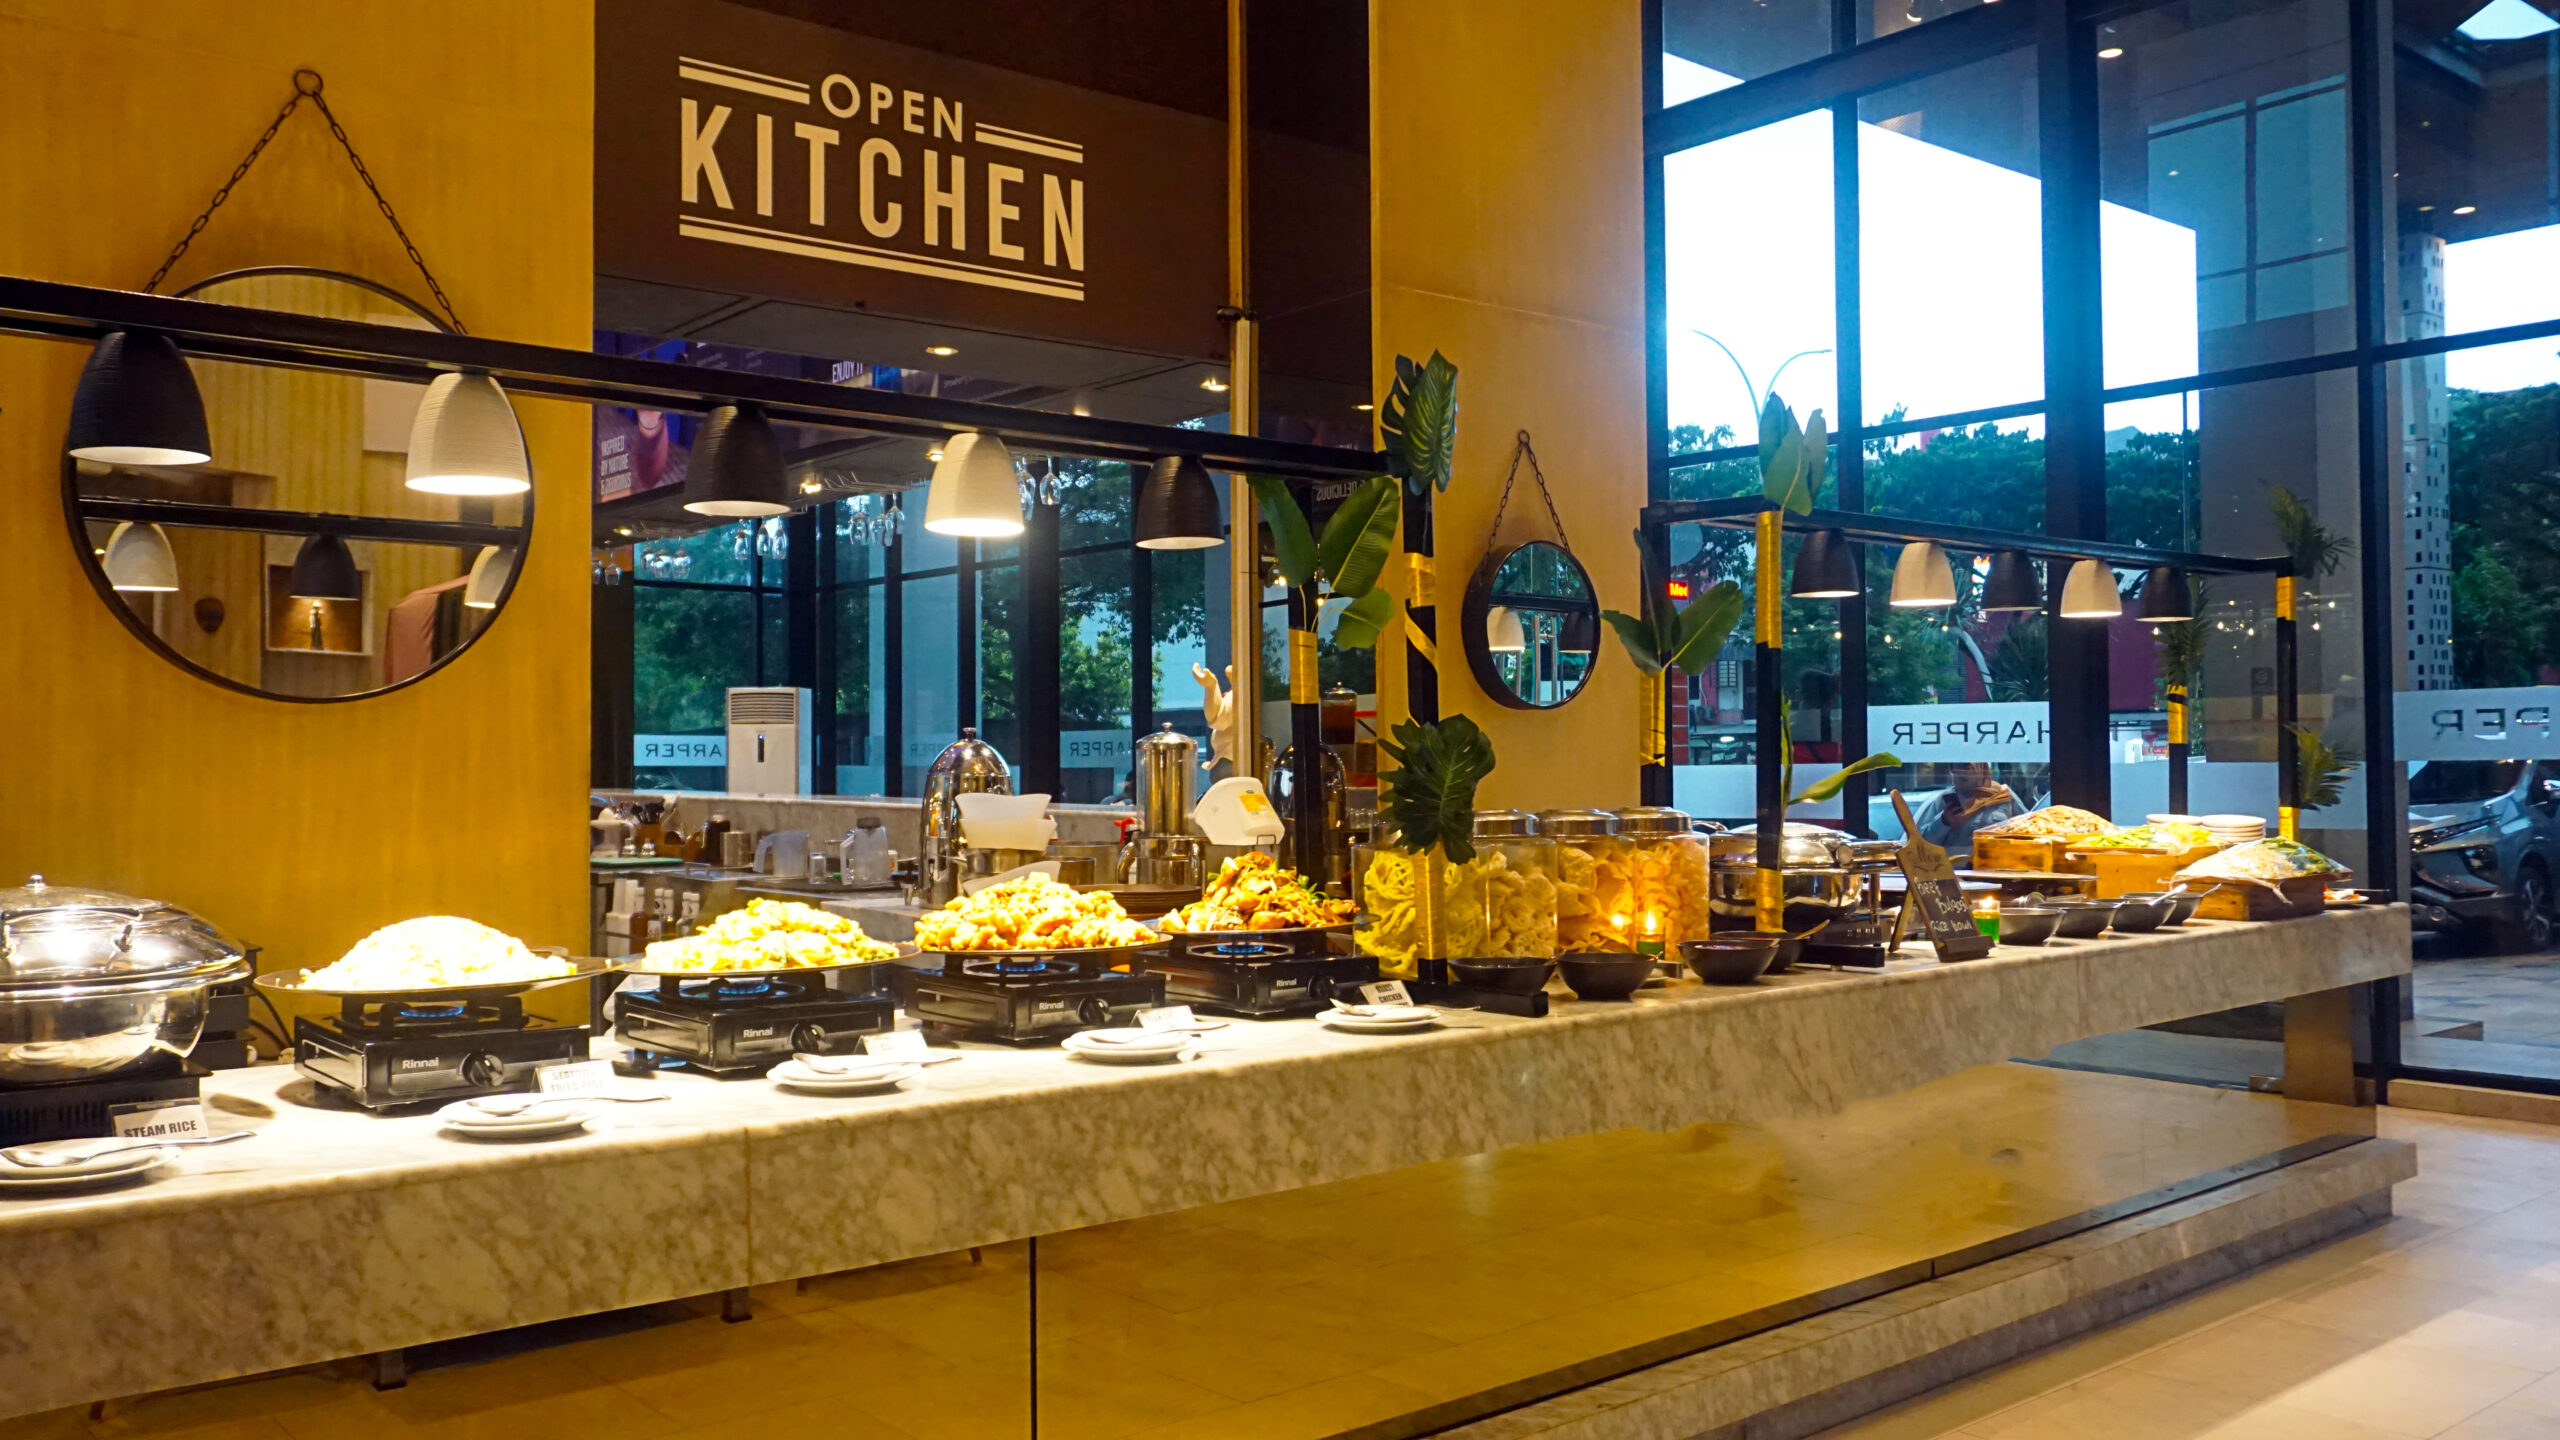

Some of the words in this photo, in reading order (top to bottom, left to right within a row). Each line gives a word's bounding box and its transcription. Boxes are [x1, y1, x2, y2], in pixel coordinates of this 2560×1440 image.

[821, 73, 963, 143] OPEN
[680, 98, 1085, 271] KITCHEN
[831, 361, 854, 384] ENJOY
[601, 435, 625, 457] INSPIRED
[609, 453, 629, 474] NATURE
[1276, 978, 1297, 987] Rinnai
[1039, 1000, 1064, 1010] Rinnai
[743, 1026, 773, 1038] Rinnai
[402, 1057, 439, 1069] Rinnai
[124, 1124, 166, 1137] STEAM
[169, 1120, 197, 1134] RICE
